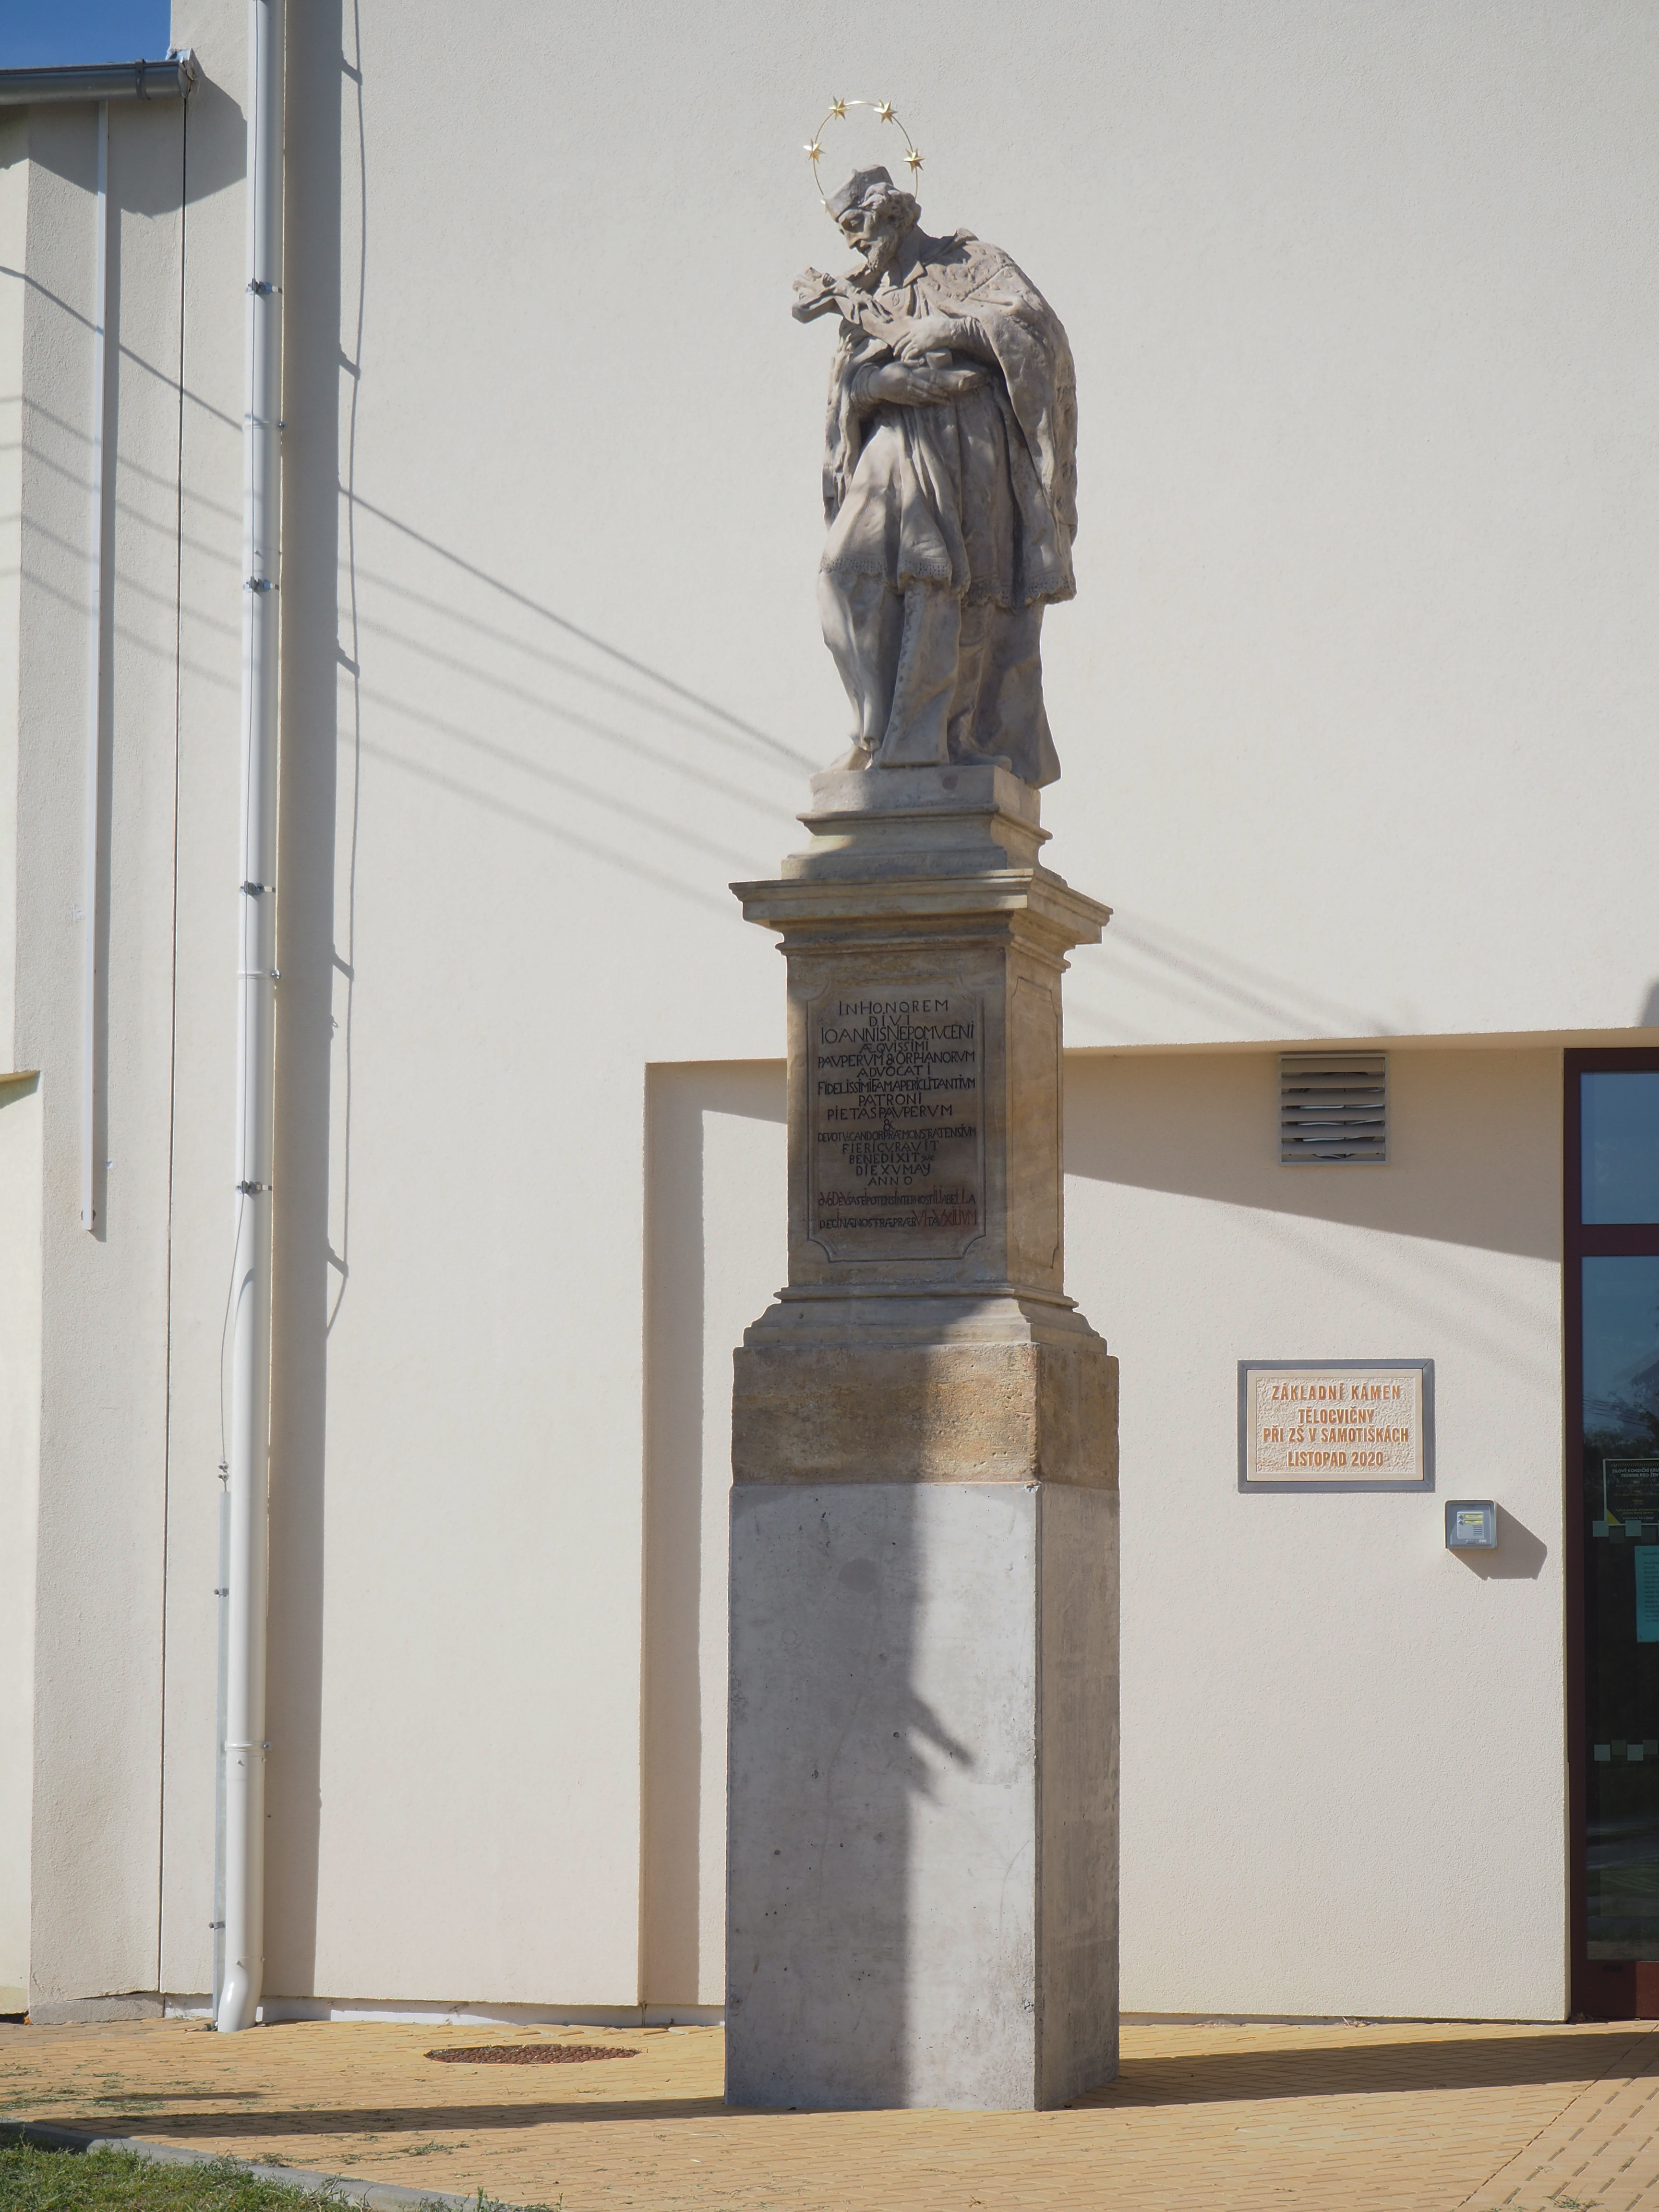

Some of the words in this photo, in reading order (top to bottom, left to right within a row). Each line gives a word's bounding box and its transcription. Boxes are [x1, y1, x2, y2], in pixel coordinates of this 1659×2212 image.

[861, 1000, 948, 1014] HONOREM
[869, 1012, 909, 1026] DIVI
[818, 1055, 883, 1068] PAVPERVM
[857, 1062, 930, 1077] ADVOCATI
[859, 1093, 922, 1106] PATRONI
[828, 1106, 876, 1120] PIETAS
[879, 1105, 952, 1118] PAVPERVM
[868, 1176, 912, 1186] ANNO
[1272, 1382, 1343, 1400] ZÁKLADNÍ
[1351, 1382, 1400, 1400] KÁMEN
[1298, 1406, 1374, 1424] TĚLOCVIČNY
[1262, 1425, 1283, 1442] PŘI
[1288, 1425, 1304, 1442] ZŠ
[1309, 1428, 1316, 1442] V
[1321, 1425, 1408, 1443] SAMOTIŠKÁCH
[1287, 1452, 1347, 1467] LISTOPAD
[1351, 1451, 1383, 1467] 2020
